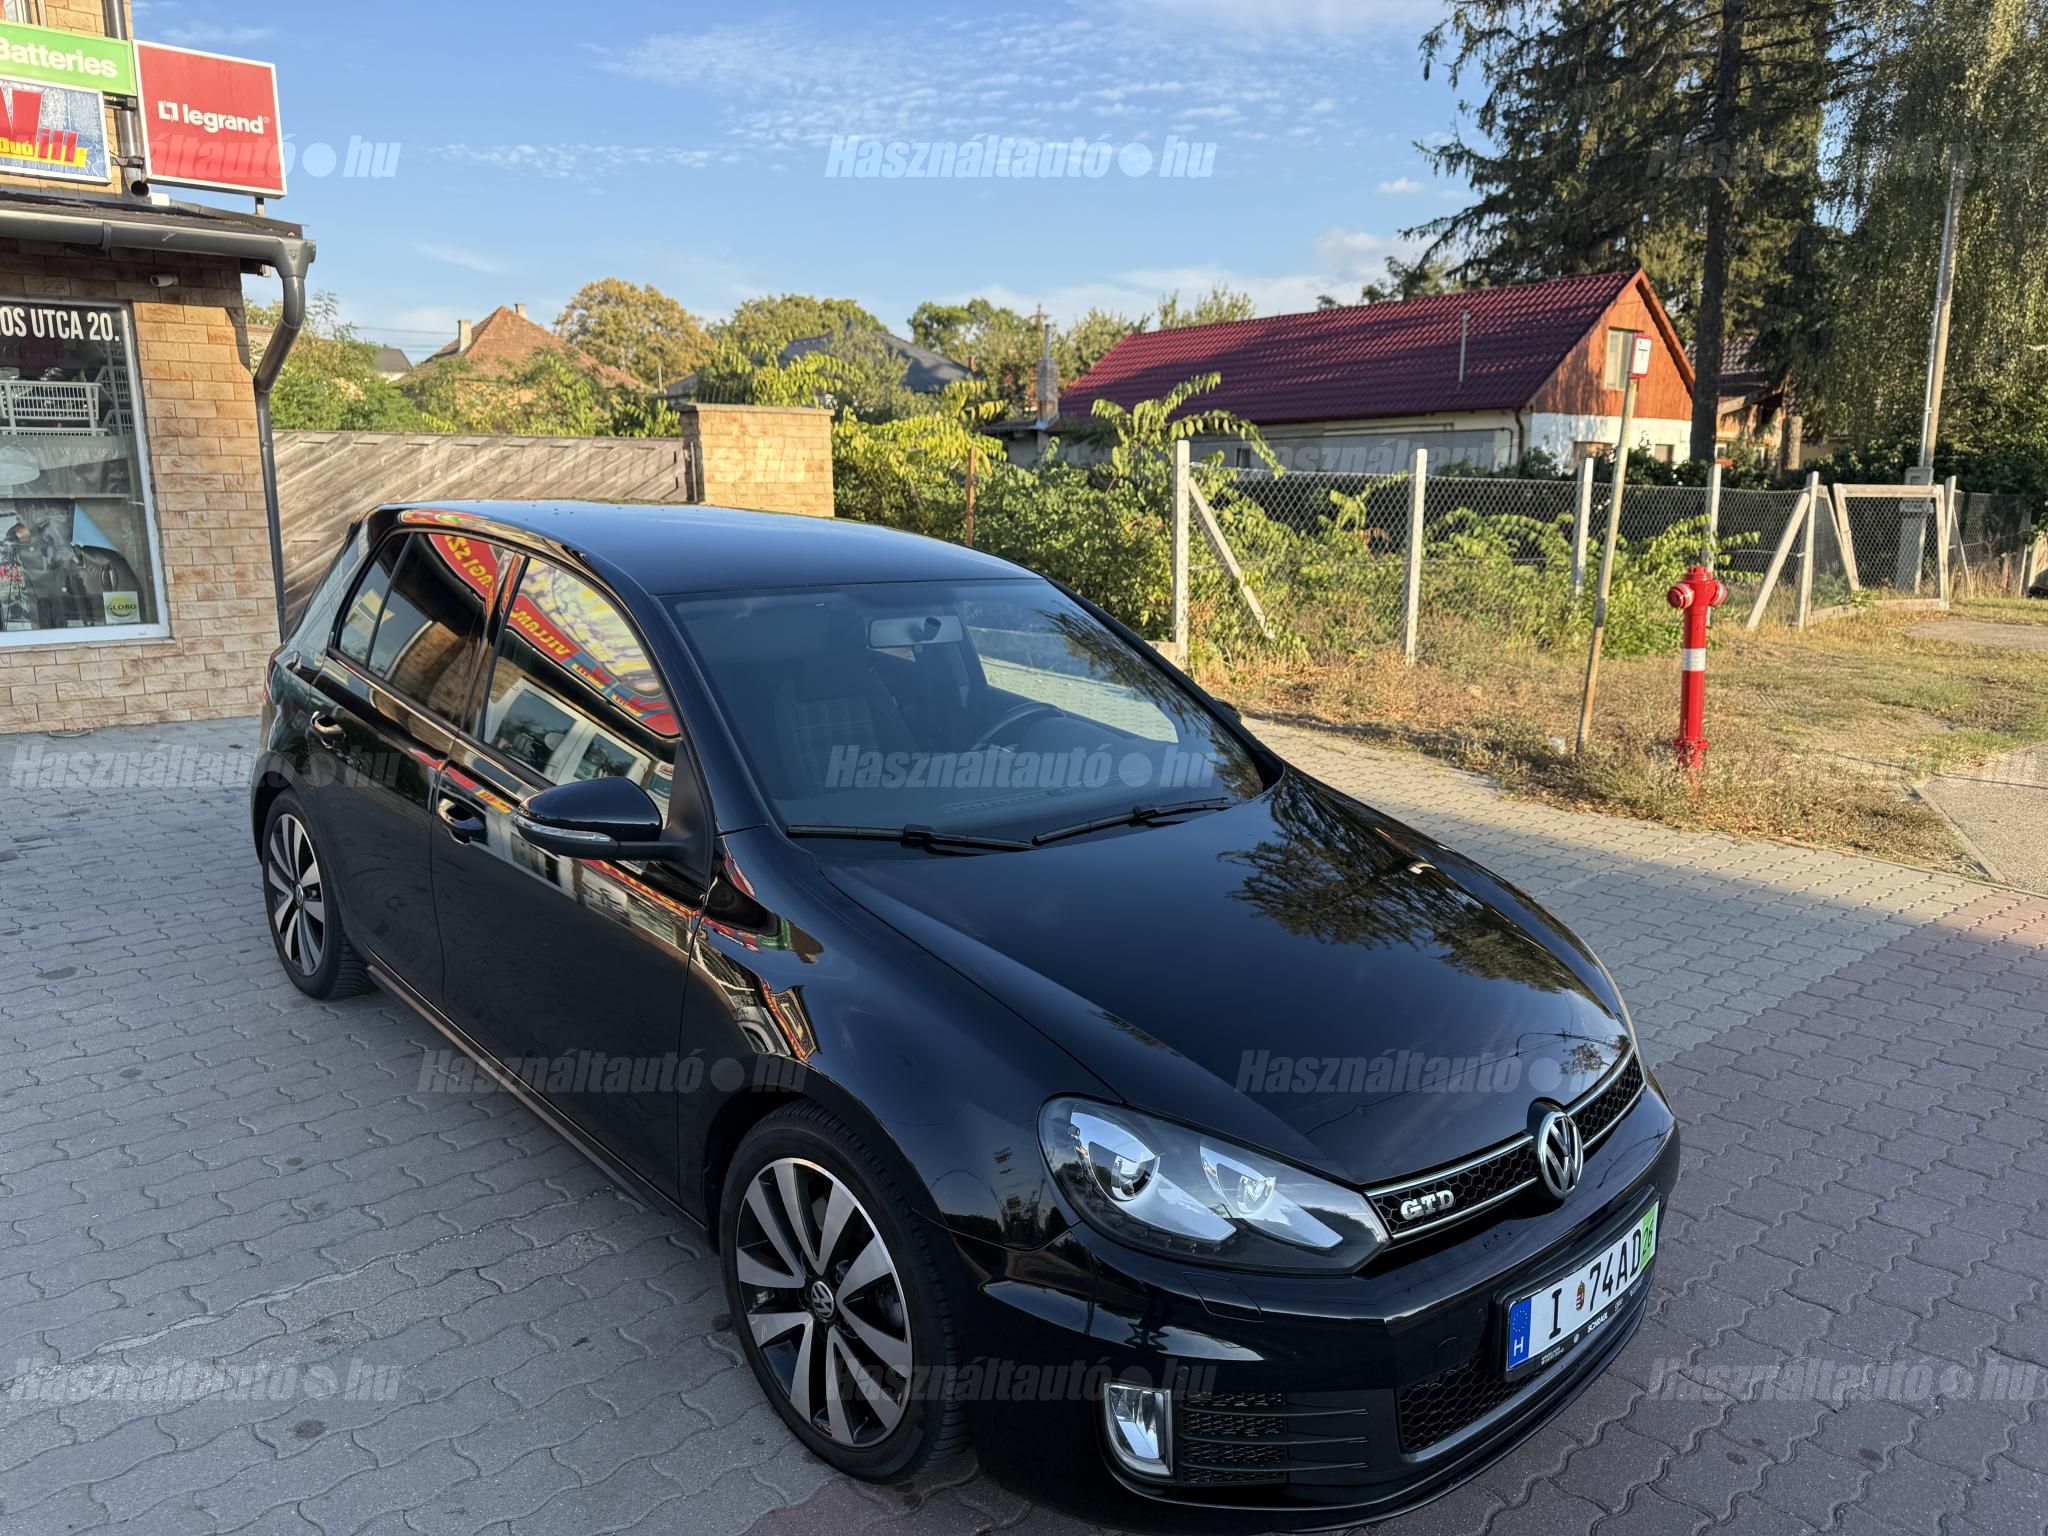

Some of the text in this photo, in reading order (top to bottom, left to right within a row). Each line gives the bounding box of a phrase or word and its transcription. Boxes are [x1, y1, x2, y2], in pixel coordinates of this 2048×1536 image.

[0, 36, 118, 79] Batteries
[0, 306, 120, 342] OS UTCA 20.
[1401, 1190, 1454, 1220] GTD
[1513, 1336, 1524, 1356] H
